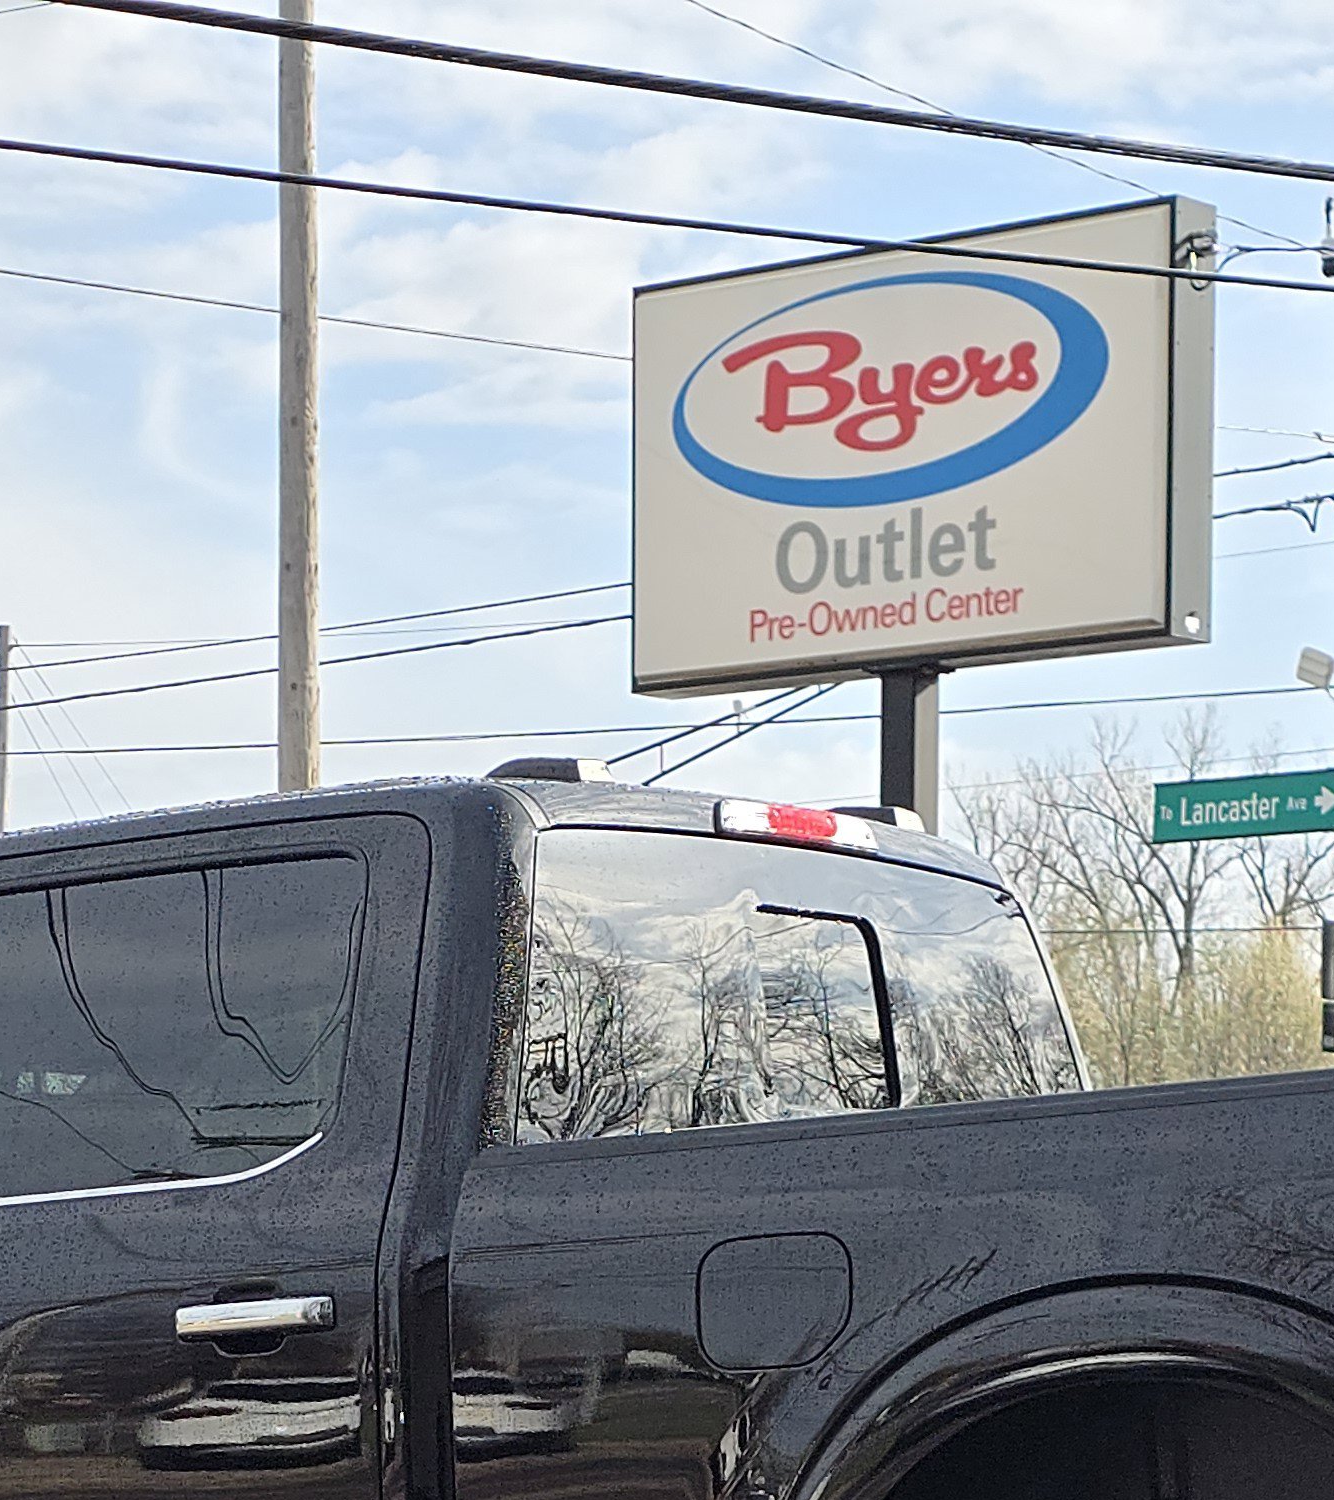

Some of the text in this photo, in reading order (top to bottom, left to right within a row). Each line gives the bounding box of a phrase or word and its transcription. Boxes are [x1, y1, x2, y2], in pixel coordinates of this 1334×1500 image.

[721, 330, 1039, 452] Byers
[775, 505, 997, 594] Outlet
[748, 587, 1024, 643] Pre-Owned Center
[1159, 791, 1308, 827] To Lancaster Ave
